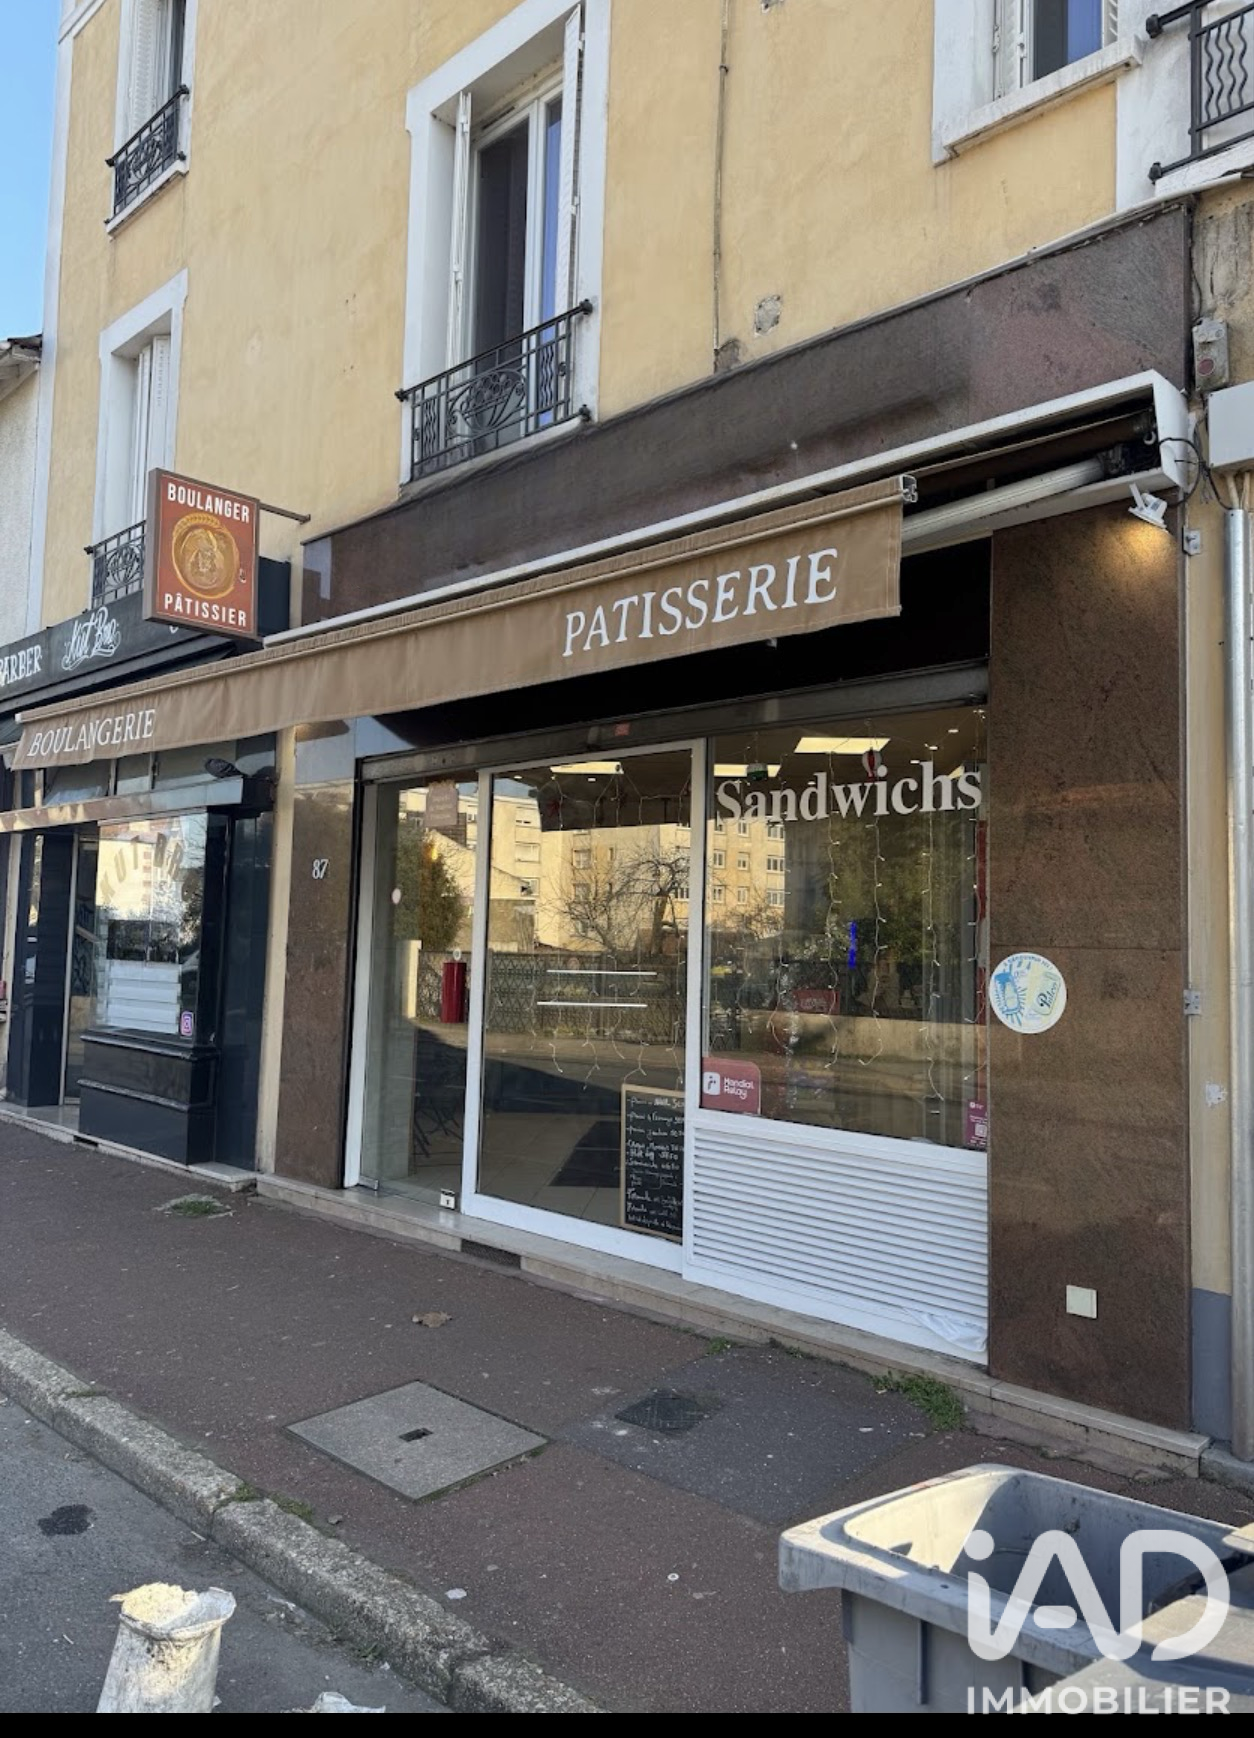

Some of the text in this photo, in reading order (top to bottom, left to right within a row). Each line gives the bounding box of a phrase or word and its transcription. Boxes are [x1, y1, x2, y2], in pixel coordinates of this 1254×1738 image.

[167, 482, 250, 523] BOULANGER
[164, 593, 247, 627] PÂTISSIER
[562, 548, 838, 657] PATISSERIE
[27, 709, 156, 756] BOULANGERIE
[717, 760, 983, 826] Sandwichs
[312, 858, 329, 879] 87
